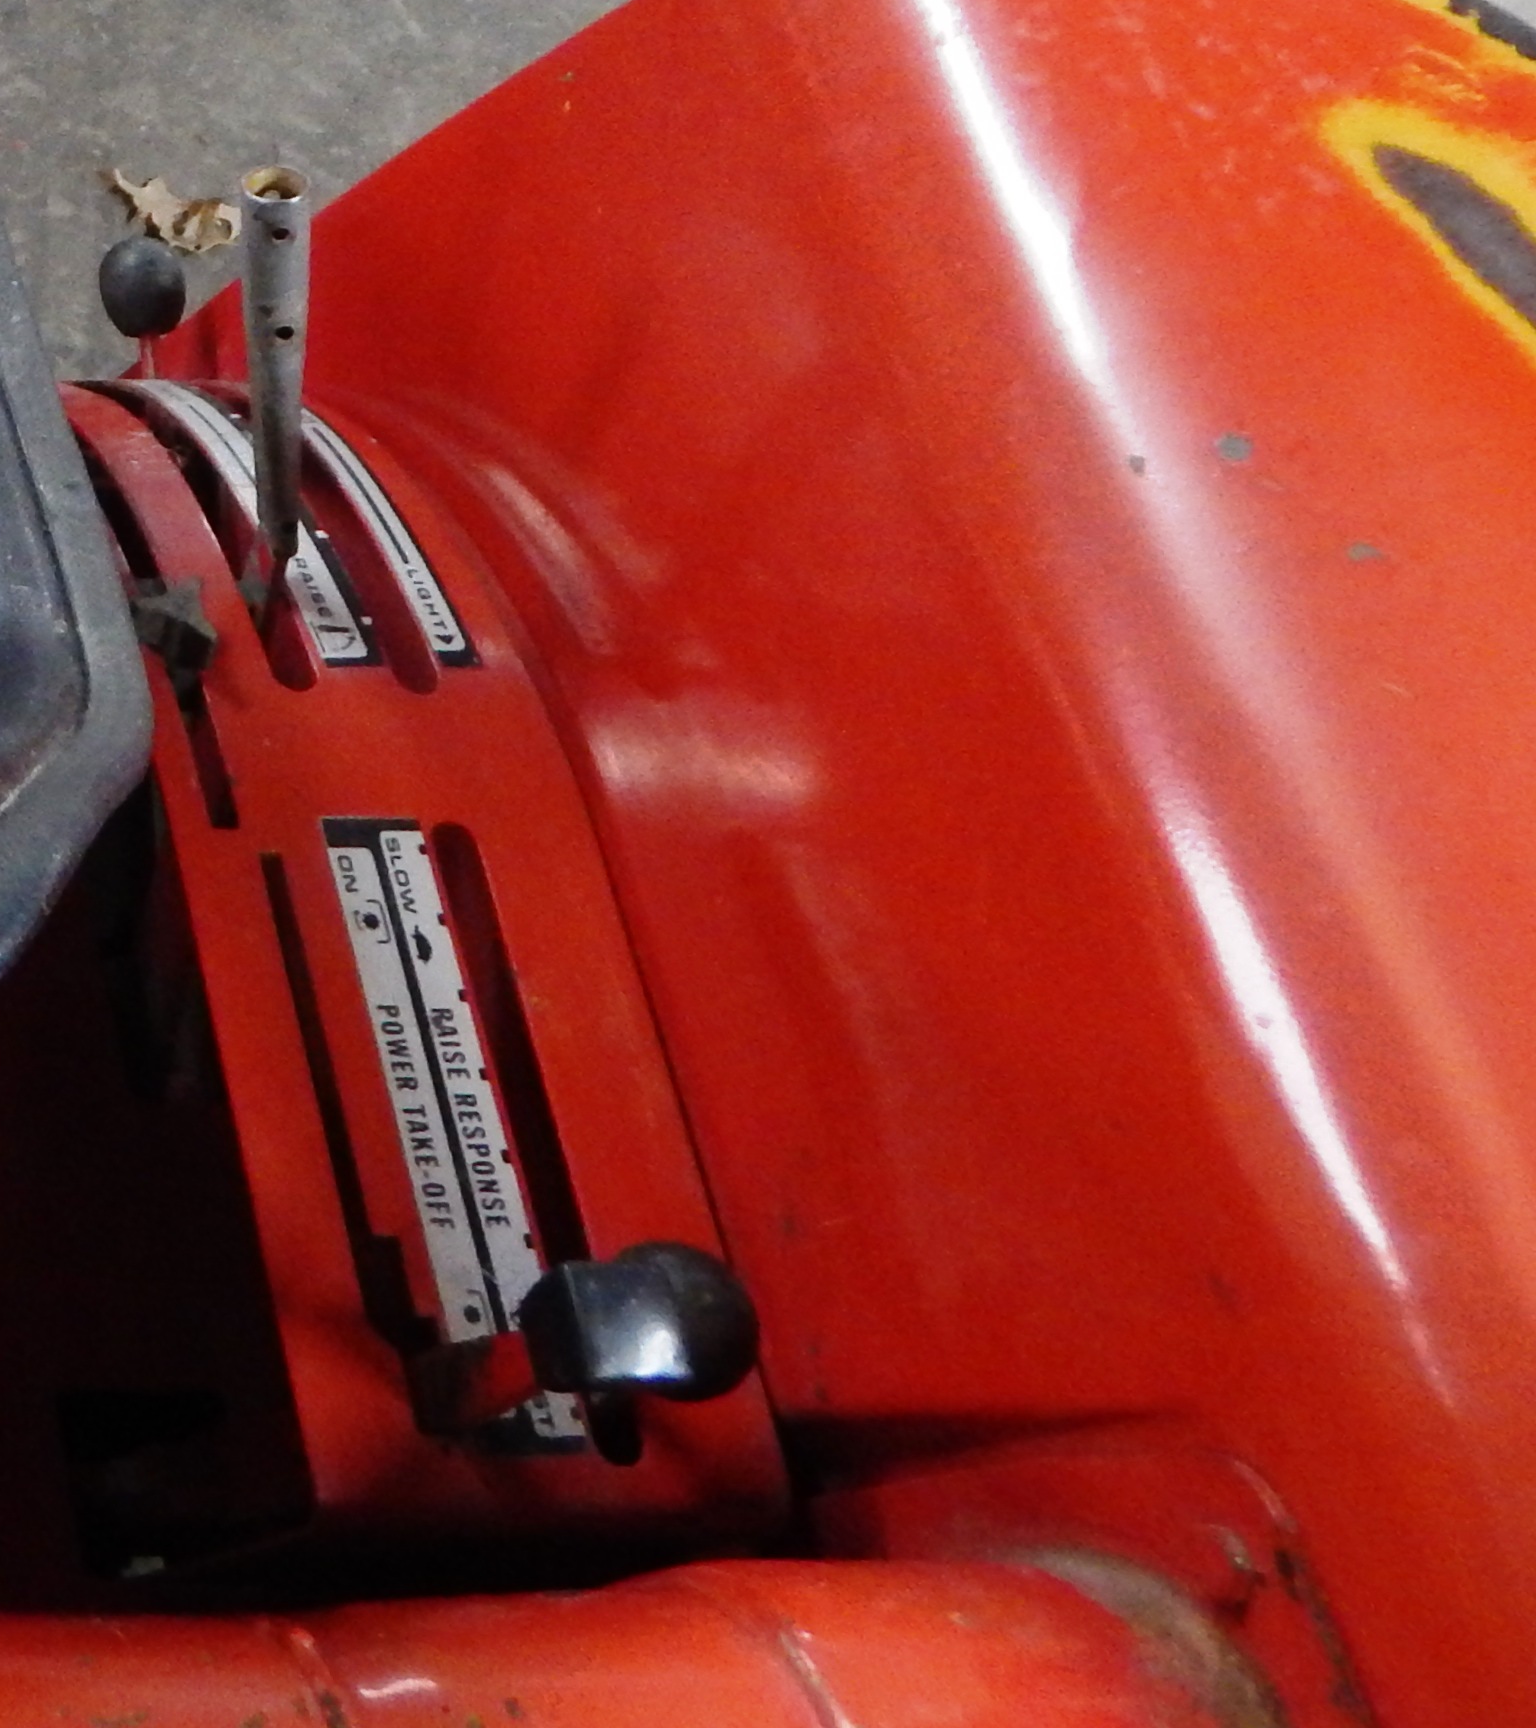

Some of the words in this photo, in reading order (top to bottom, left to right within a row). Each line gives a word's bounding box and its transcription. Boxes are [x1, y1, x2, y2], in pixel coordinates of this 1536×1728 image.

[295, 557, 333, 619] RAISE
[406, 568, 449, 631] LIGHT
[337, 854, 359, 894] ON
[384, 836, 418, 915] SLOW
[376, 1003, 419, 1091] POWER
[402, 1104, 456, 1230] TAKE-OFF
[429, 1007, 472, 1082] RAISE
[453, 1092, 512, 1229] RESPONSE
